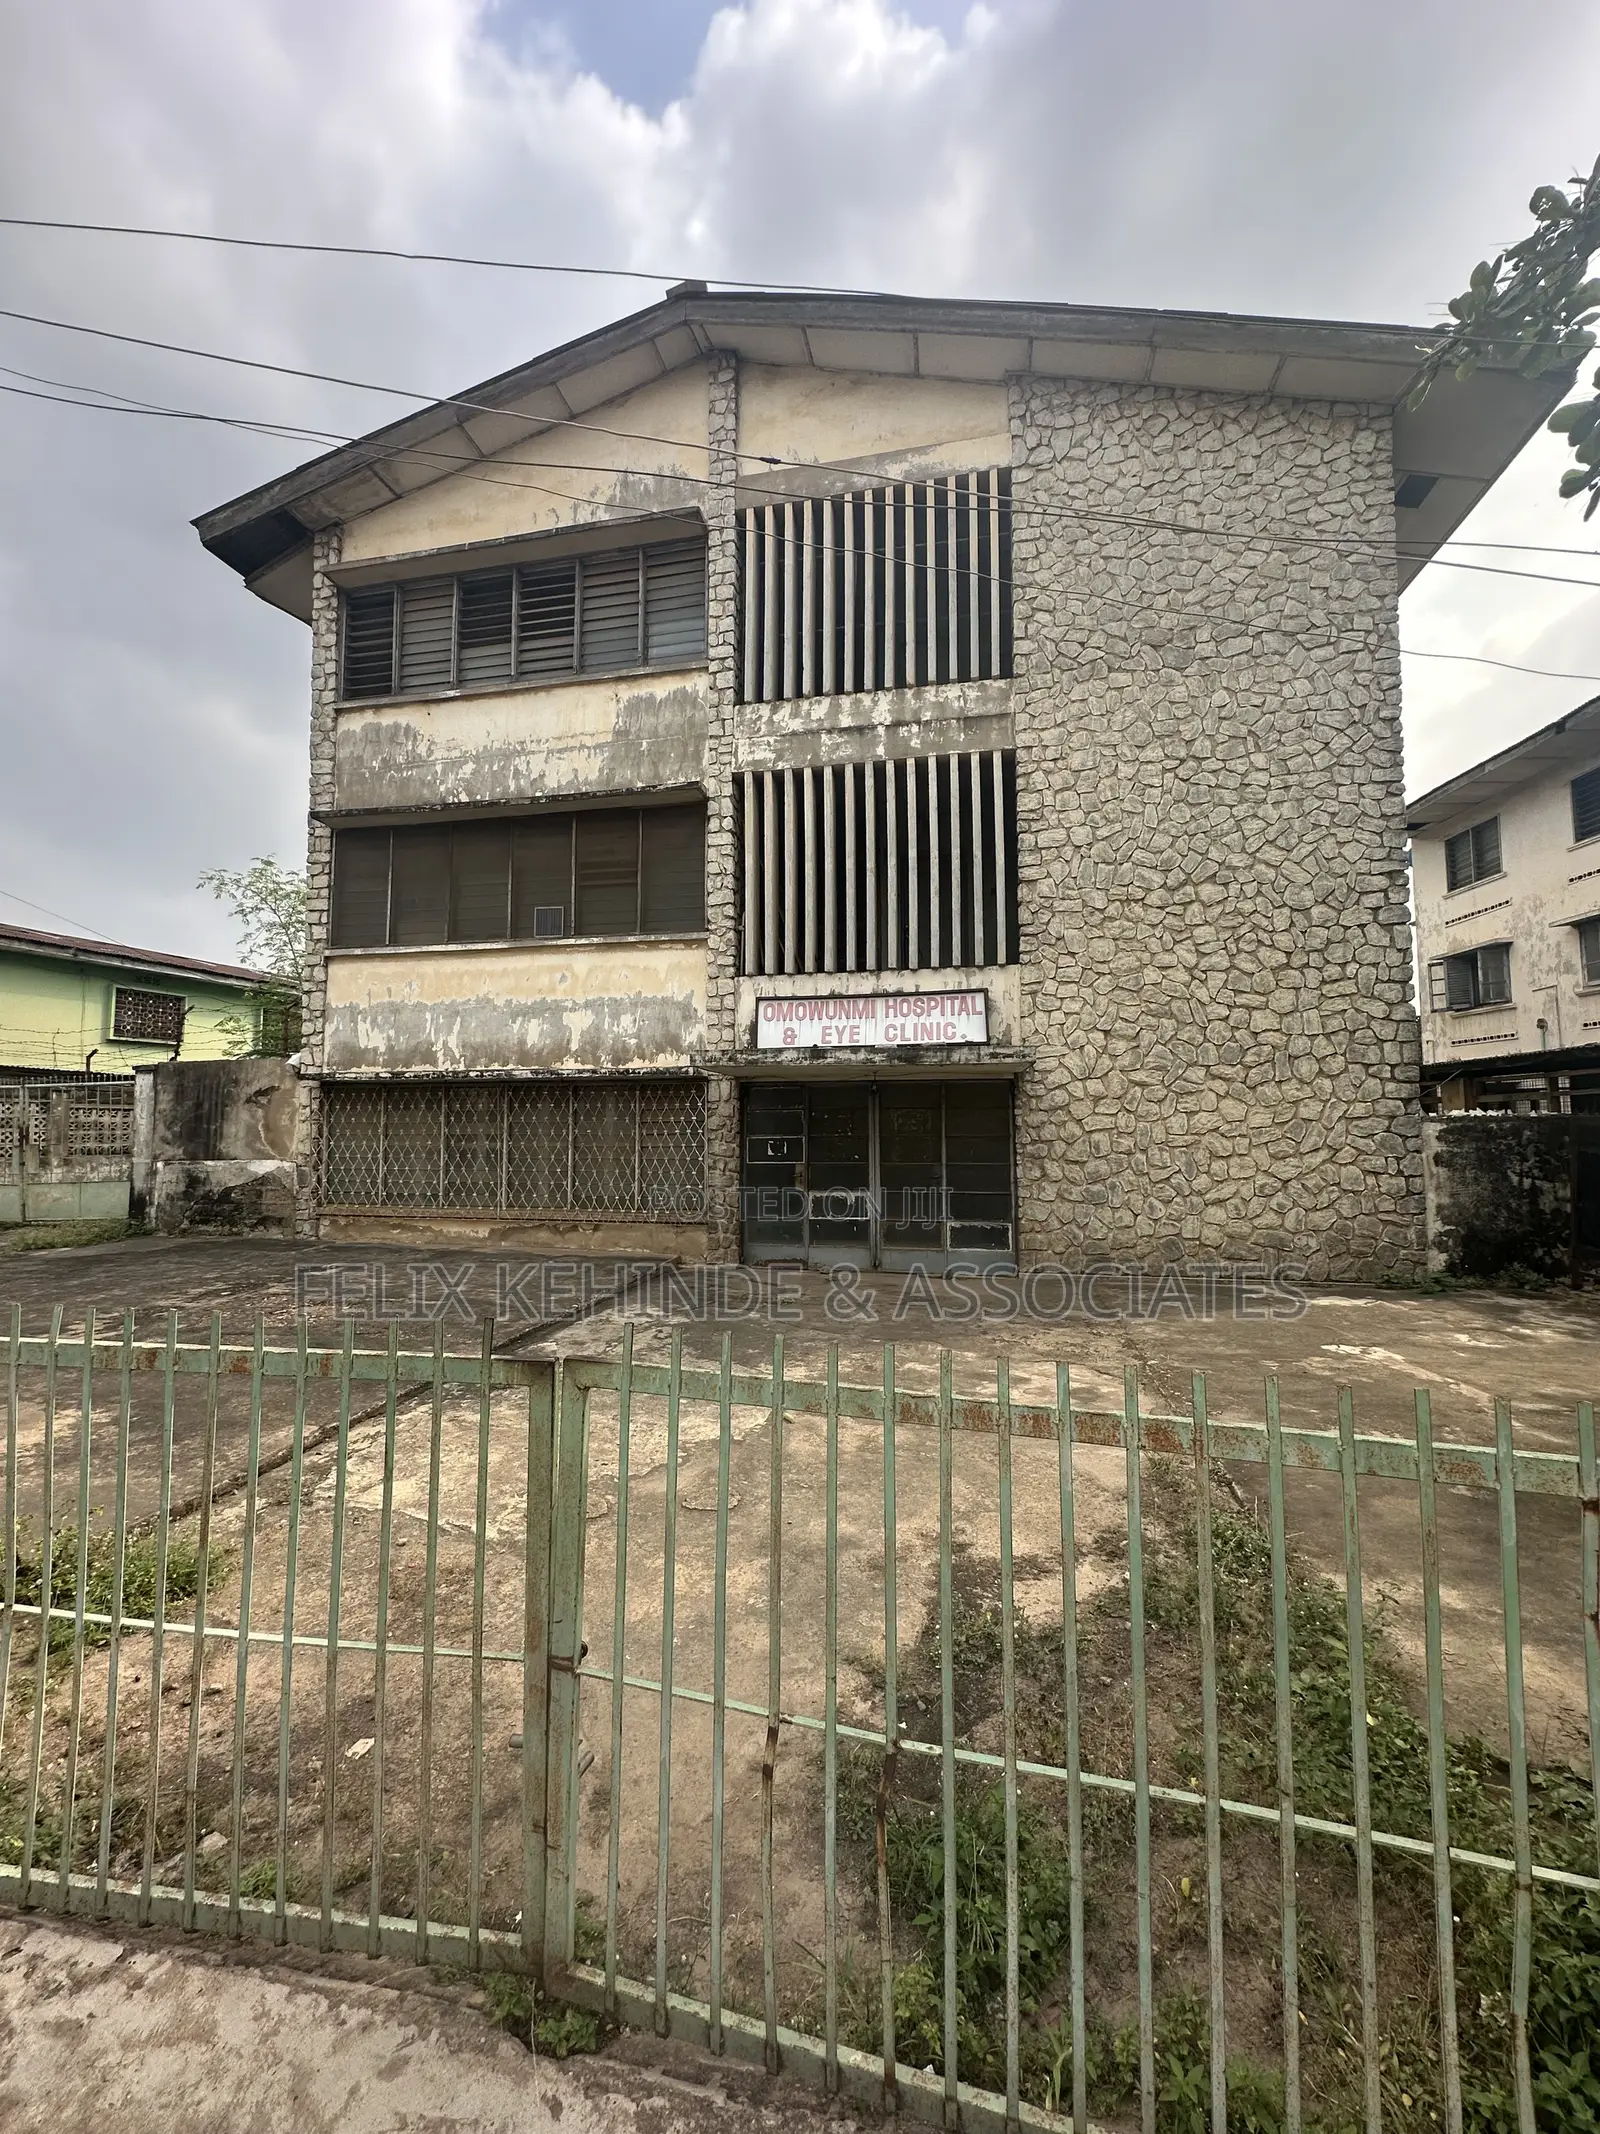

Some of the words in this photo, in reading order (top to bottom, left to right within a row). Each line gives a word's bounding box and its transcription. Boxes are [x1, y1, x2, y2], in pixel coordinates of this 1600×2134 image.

[763, 999, 876, 1022] OMOWUNMI
[884, 995, 983, 1018] HOSPITAL
[783, 1027, 797, 1045] &
[821, 1025, 860, 1044] EYE
